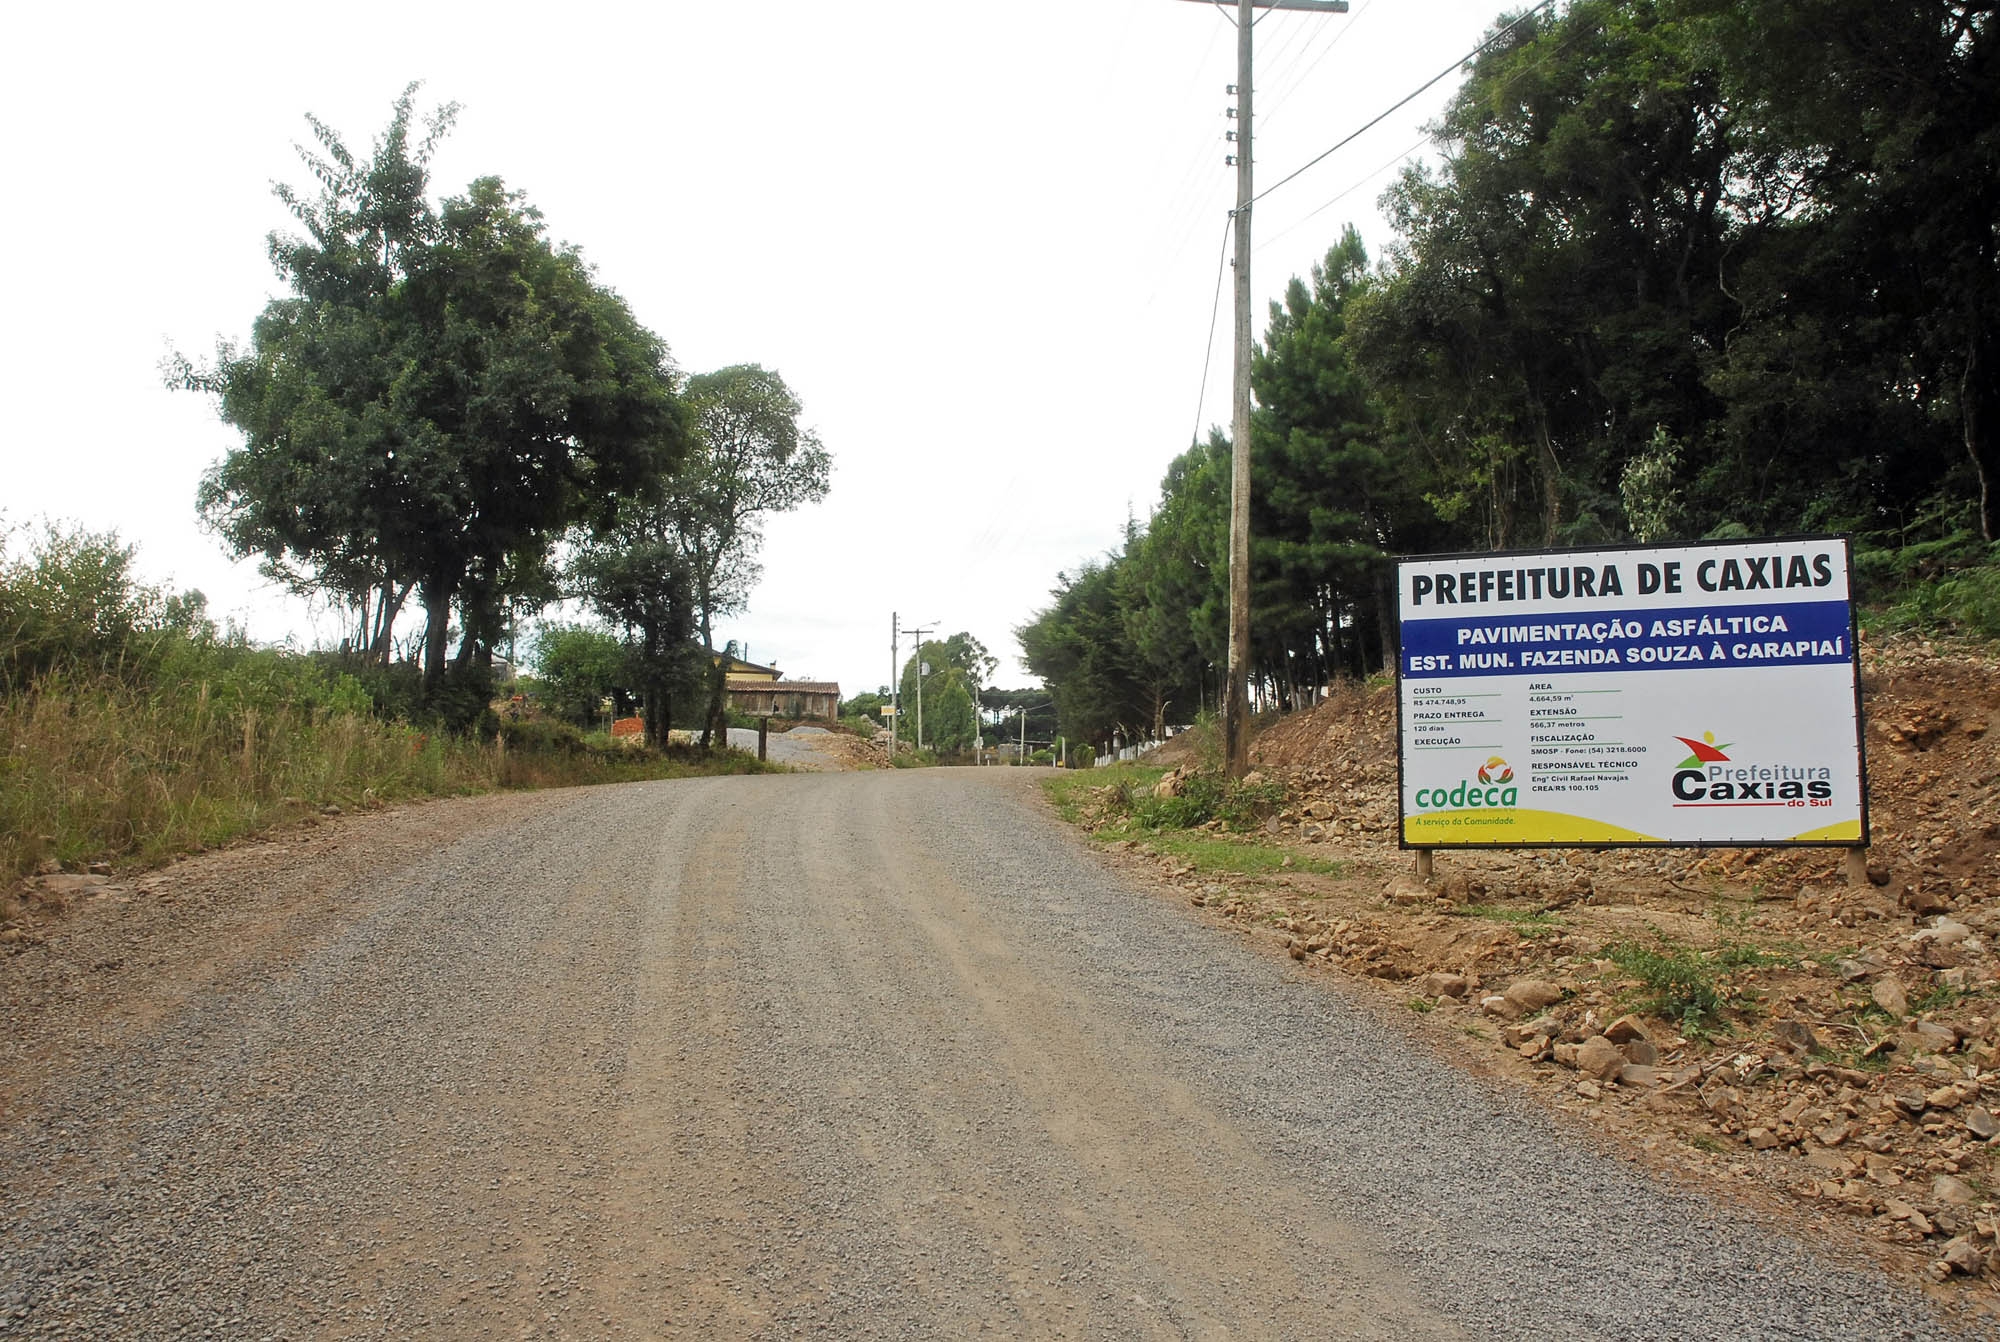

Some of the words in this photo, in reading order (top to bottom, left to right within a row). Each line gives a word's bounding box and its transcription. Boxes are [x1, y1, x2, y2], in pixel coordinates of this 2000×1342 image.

[1412, 565, 1624, 606] PREFEITURA
[1637, 561, 1682, 595] DE
[1696, 554, 1832, 592] CAXIAS
[1457, 619, 1642, 645] PAVIMENTAÇÃO
[1650, 615, 1788, 638] ASFÁLTICA
[1410, 655, 1453, 672] EST.
[1459, 653, 1515, 670] MUN.
[1521, 648, 1620, 667] FAZENDA
[1626, 645, 1704, 663] SOUZA
[1709, 641, 1726, 660] À
[1732, 636, 1843, 659] CARAPIAÍ
[1413, 687, 1442, 695] CUSTO
[1444, 711, 1485, 719] ENTREGA
[1530, 707, 1577, 716] EXTENSÃO
[1414, 736, 1461, 746] EXECUÇÃO
[1531, 733, 1595, 742] FISCALIZAÇÃO
[1588, 747, 1604, 755] (54)
[1531, 761, 1595, 769] RESPONSÁVEL
[1598, 760, 1638, 768] TÉCNICO
[1709, 764, 1831, 781] Prefeitura
[1597, 775, 1629, 783] Navajas
[1672, 769, 1832, 801] Caxias
[1415, 780, 1518, 808] codeca
[1787, 799, 1805, 808] do
[1809, 798, 1832, 807] Sul
[1423, 818, 1450, 828] serviço
